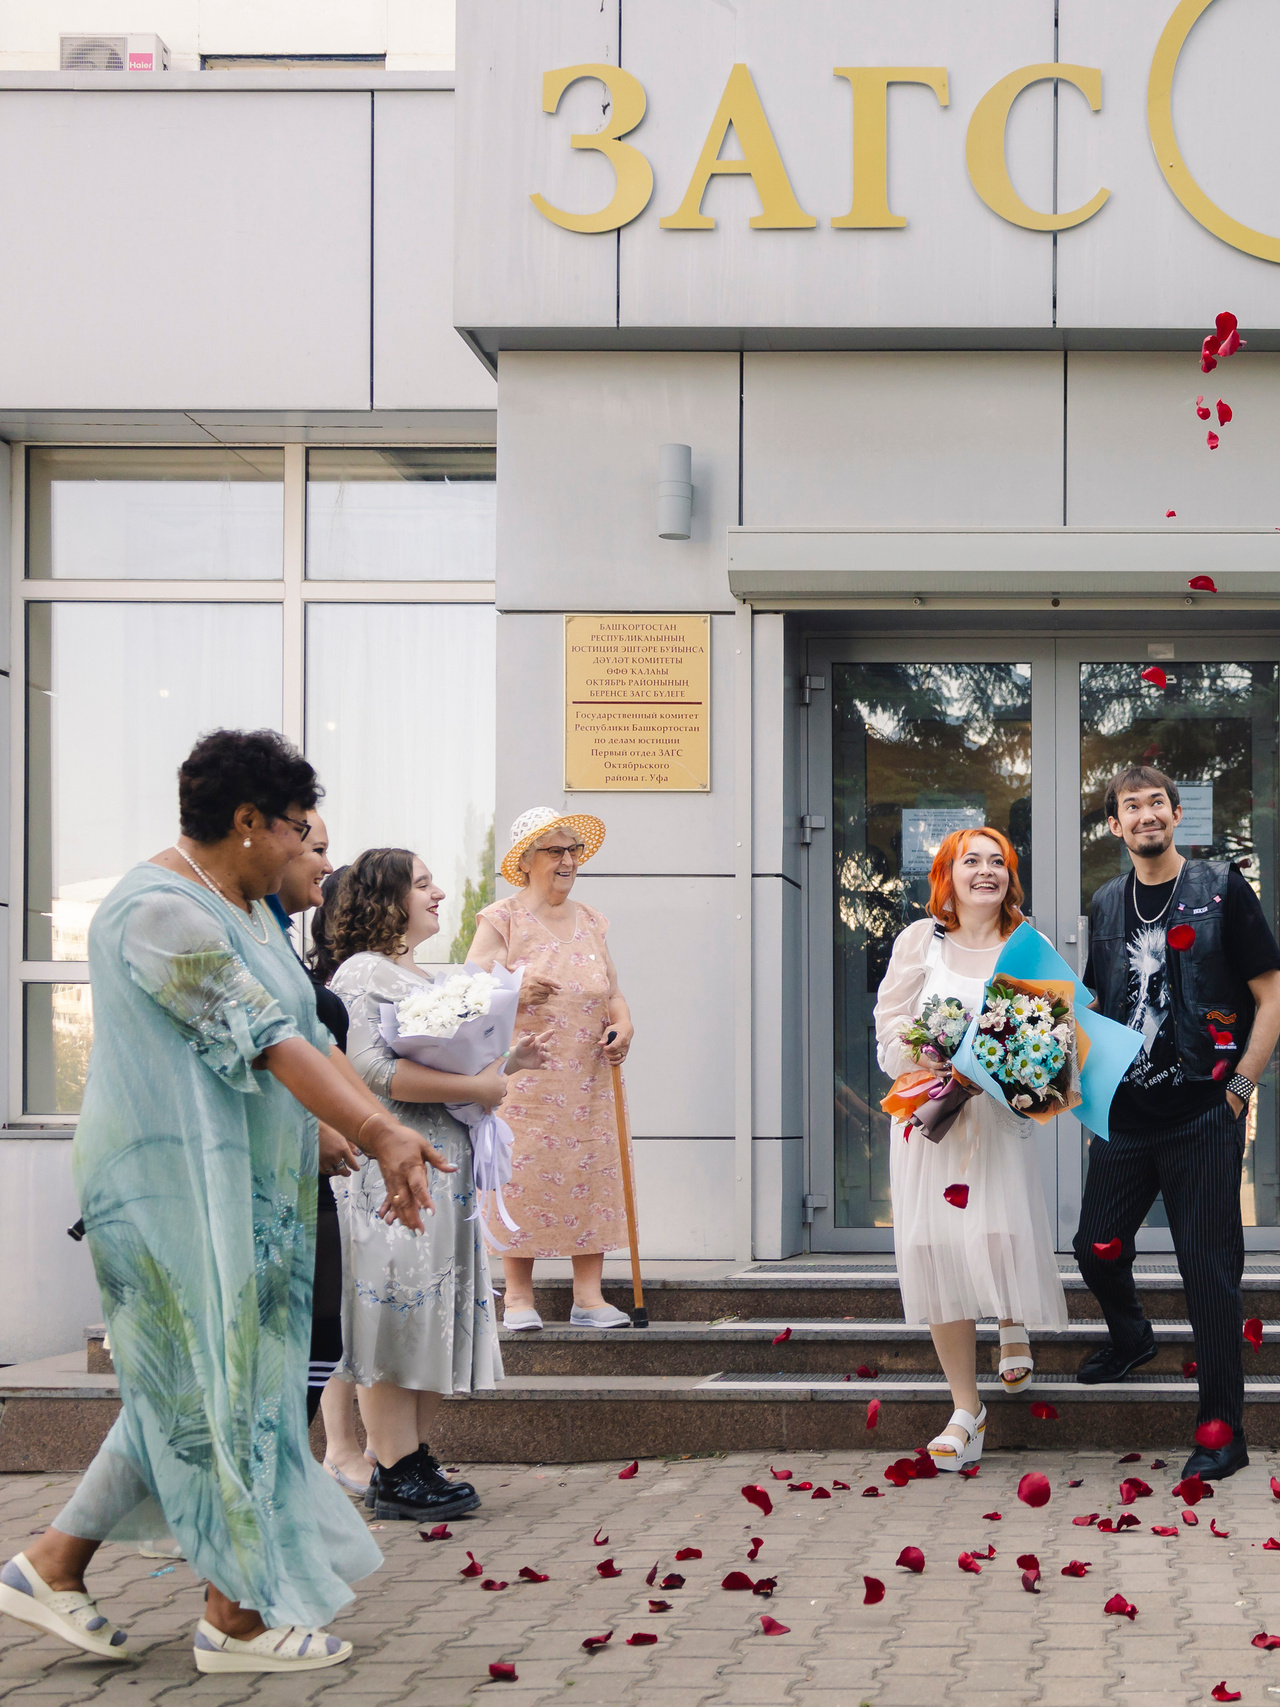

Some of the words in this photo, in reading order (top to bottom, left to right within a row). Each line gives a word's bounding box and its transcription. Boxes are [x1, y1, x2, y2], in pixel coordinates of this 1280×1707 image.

[129, 61, 151, 69] Haier
[529, 63, 1111, 234] ЗАГС
[571, 646, 619, 654] ЮСТИЦИЯ
[660, 645, 704, 653] БУЙЫНСА
[585, 679, 626, 687] ОКТЯБРЬ
[629, 690, 651, 698] ЗАГС
[575, 711, 657, 721] Государственный
[574, 723, 629, 734] Республики
[632, 724, 700, 734] Башкортостан
[591, 749, 628, 758] Первый
[658, 749, 683, 757] ЗАГС
[604, 761, 670, 771] Октябрьского
[605, 774, 639, 784] района
[649, 774, 669, 784] Уфа
